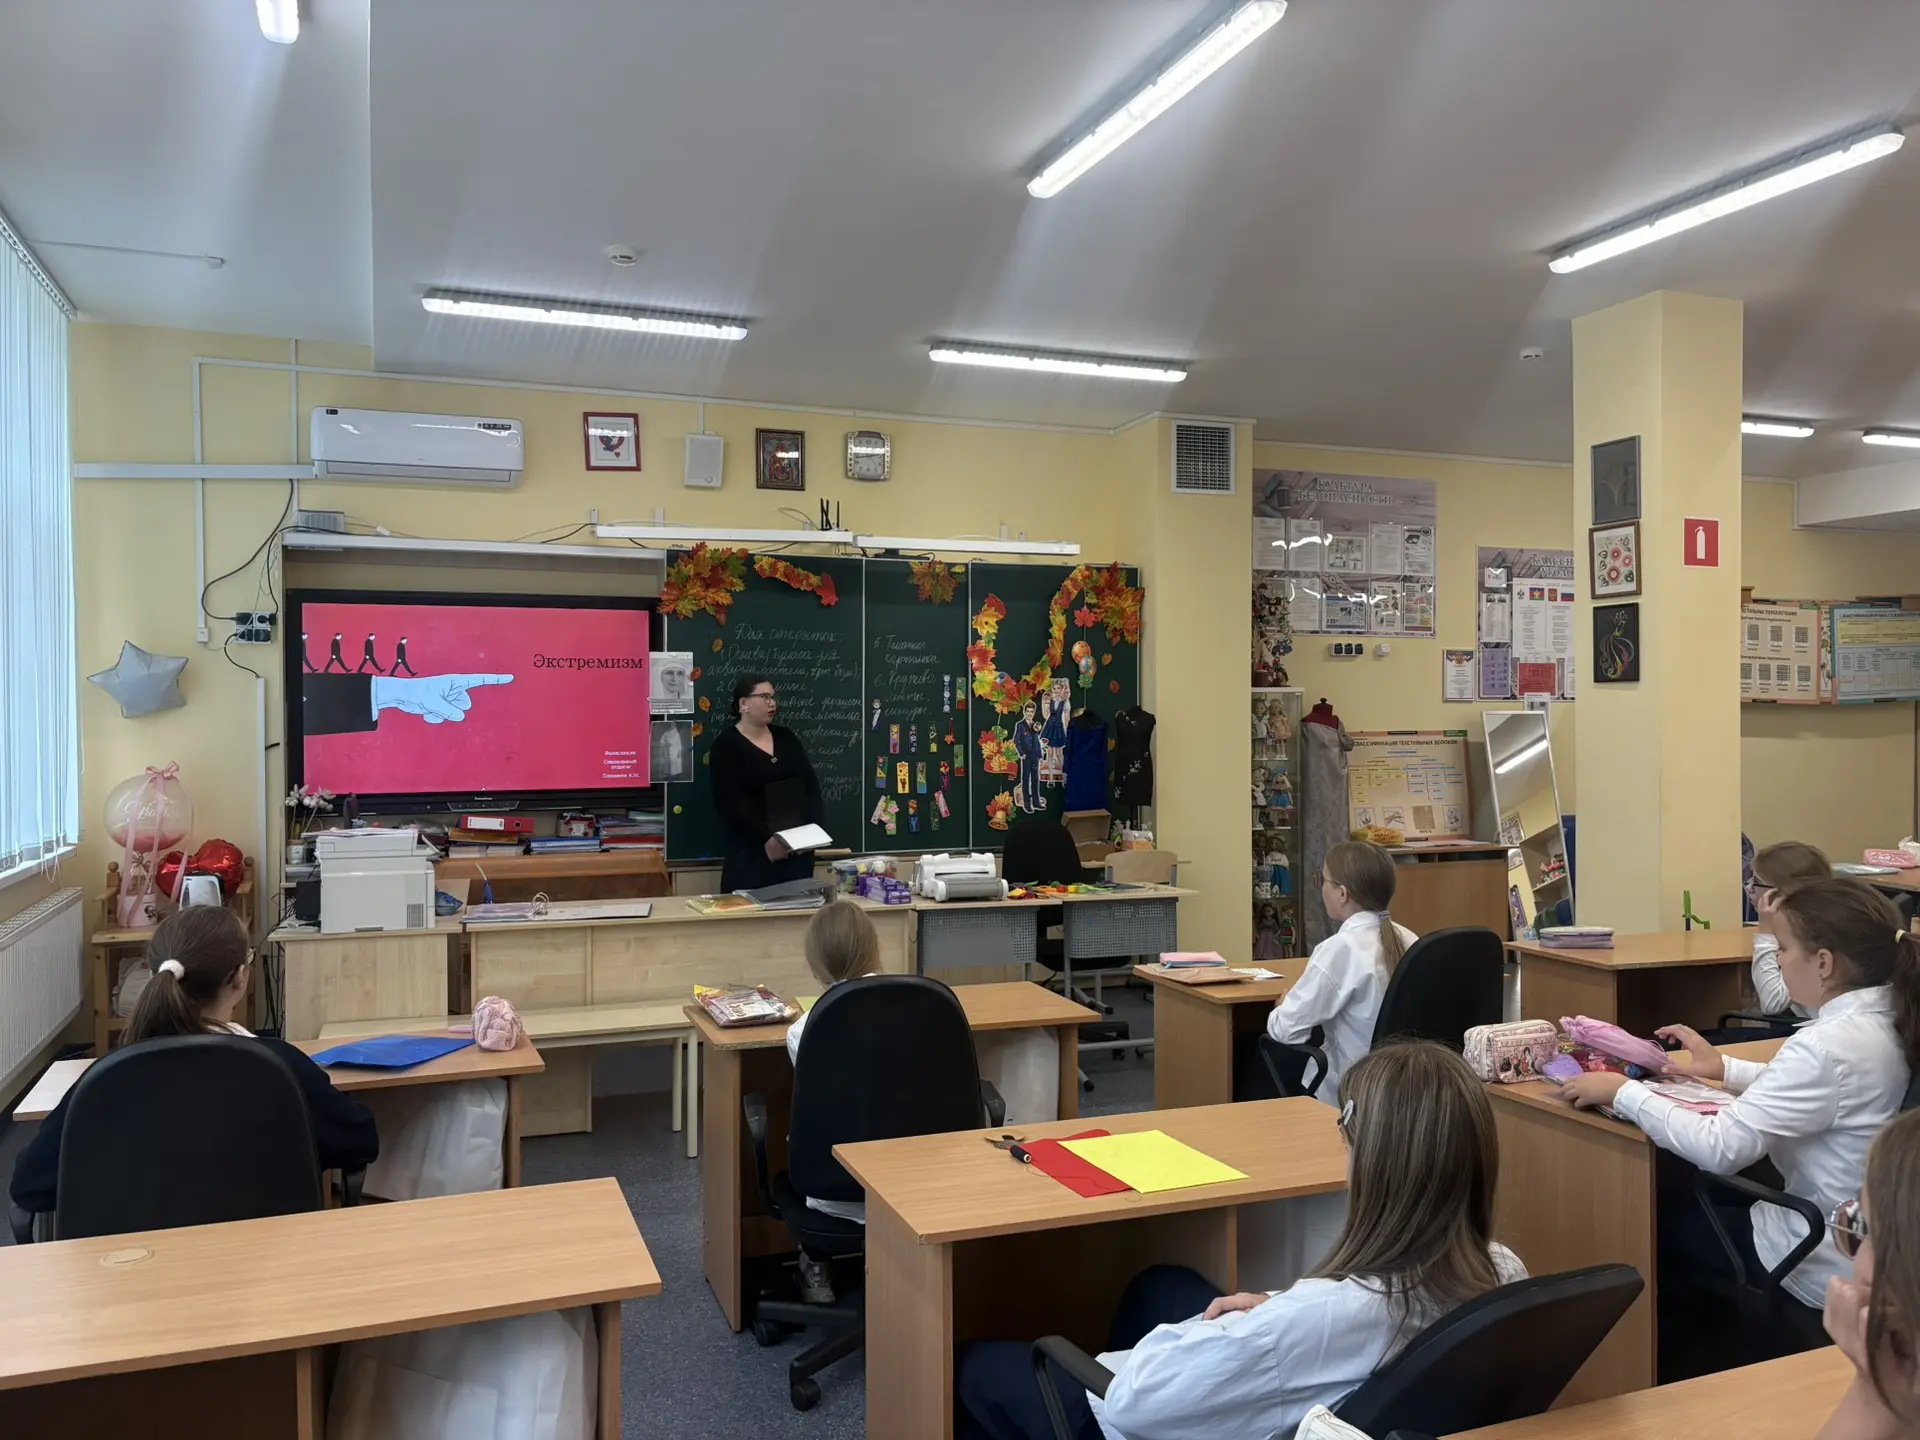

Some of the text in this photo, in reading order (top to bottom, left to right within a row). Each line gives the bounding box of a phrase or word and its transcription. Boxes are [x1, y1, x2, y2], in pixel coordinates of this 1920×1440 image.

[1317, 479, 1375, 493] КУЛЬТУРА
[1297, 490, 1393, 506] БЕЗОПАСНОСТИ
[735, 623, 765, 641] Для
[533, 653, 644, 670] Экстремизм
